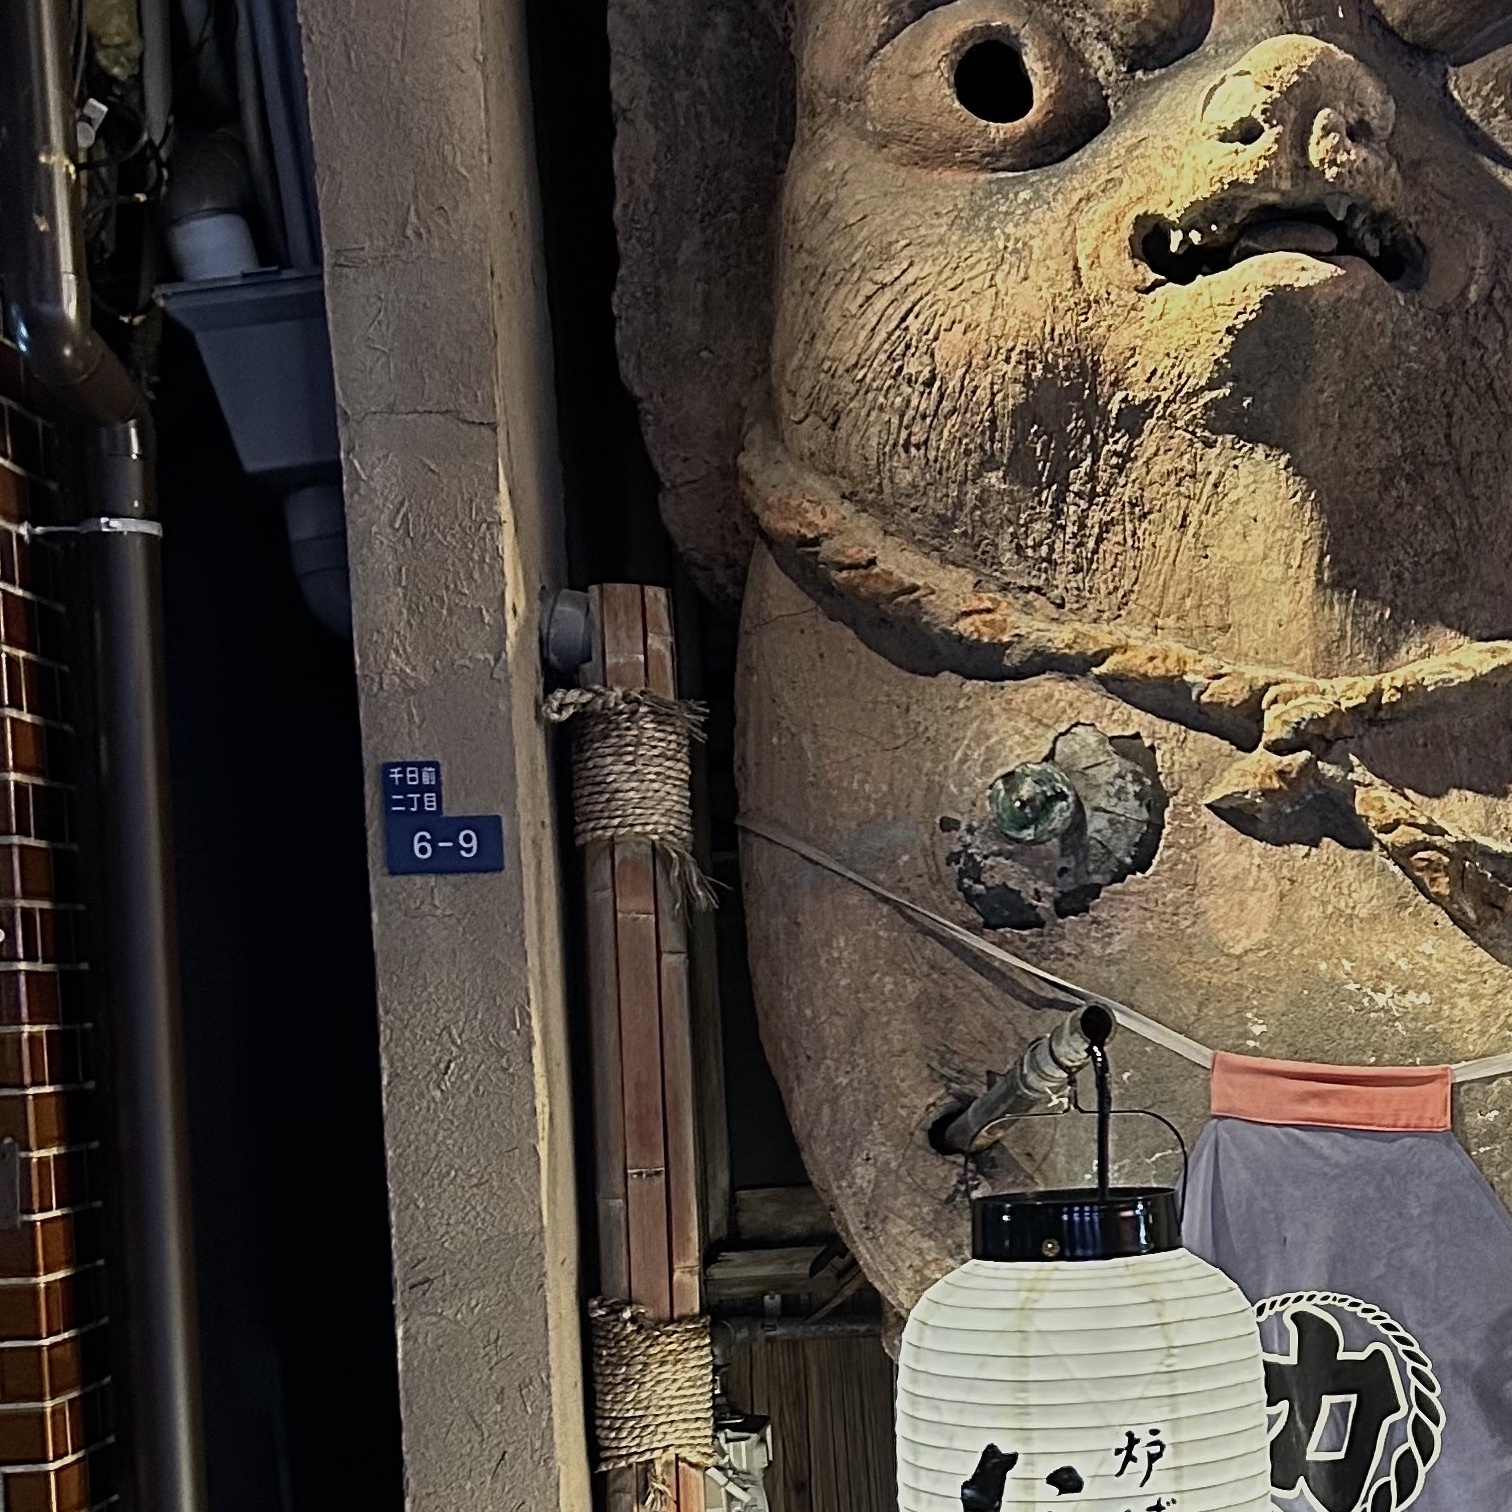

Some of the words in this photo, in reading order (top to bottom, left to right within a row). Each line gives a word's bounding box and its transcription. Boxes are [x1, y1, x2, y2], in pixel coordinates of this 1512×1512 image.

[388, 765, 437, 786] 千日前
[390, 792, 438, 812] 二丁目
[412, 828, 479, 860] 6-9
